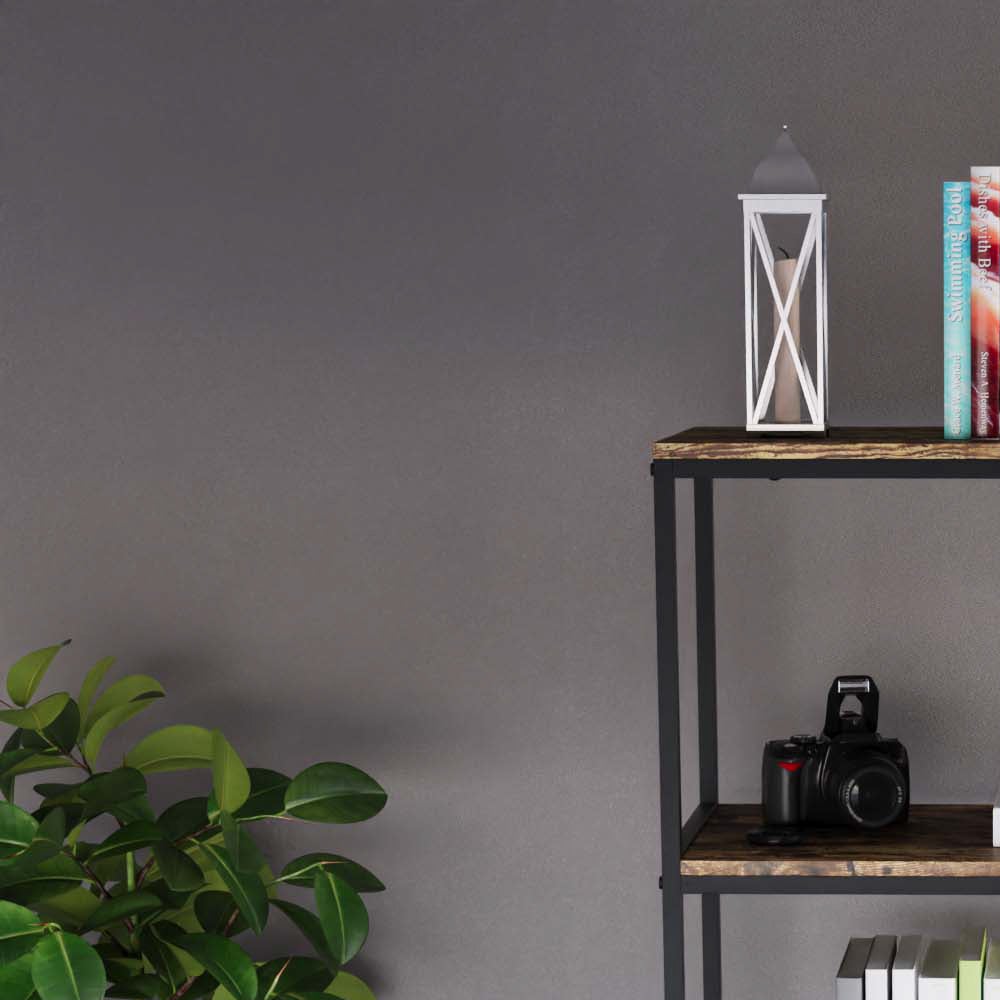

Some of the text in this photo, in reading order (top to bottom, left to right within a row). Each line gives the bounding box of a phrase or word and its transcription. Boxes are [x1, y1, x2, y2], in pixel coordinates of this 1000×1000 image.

[946, 187, 968, 323] Swimming Pool
[978, 223, 992, 253] with
